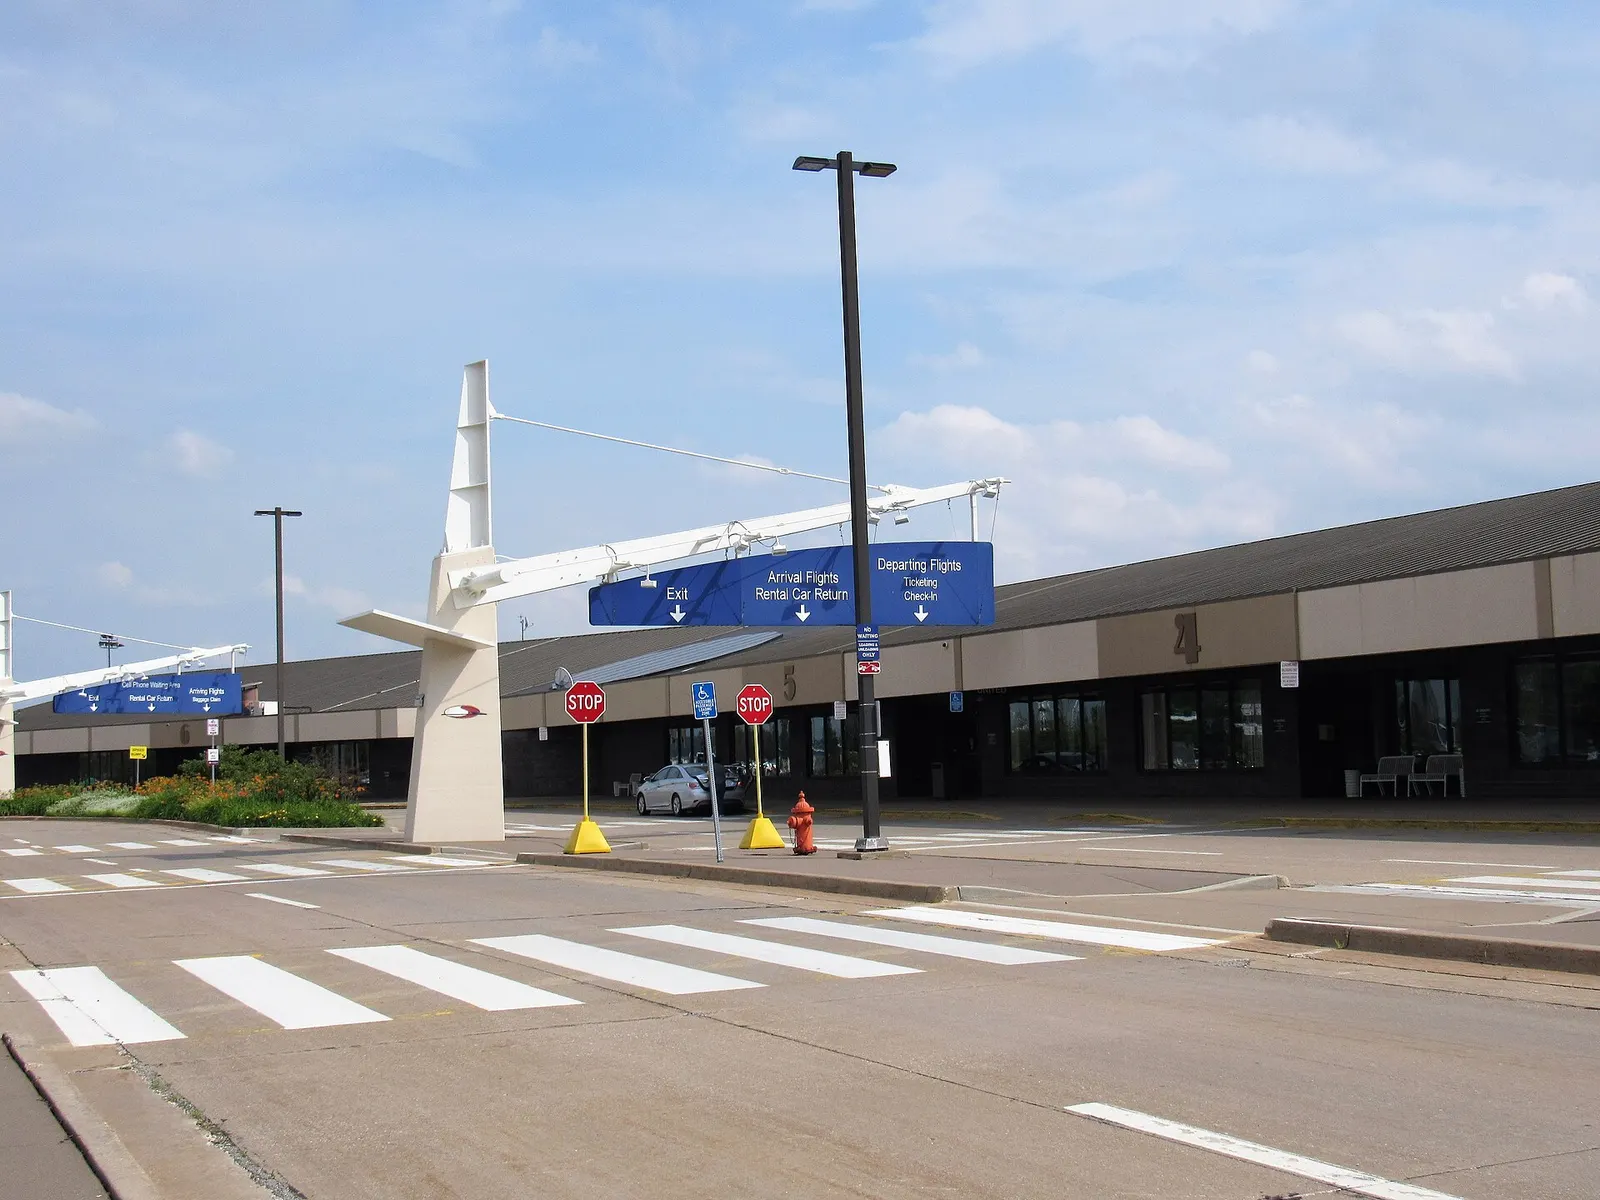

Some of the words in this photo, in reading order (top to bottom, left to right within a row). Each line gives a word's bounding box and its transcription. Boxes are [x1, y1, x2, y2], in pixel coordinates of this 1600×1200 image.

[878, 558, 926, 574] Departing
[930, 558, 962, 574] Flights
[768, 570, 802, 584] Arrival
[806, 570, 839, 586] Flights
[904, 577, 938, 589] Ticketing
[666, 587, 688, 600] Exit
[756, 588, 788, 600] Rental
[792, 588, 812, 600] Car
[815, 588, 848, 600] Return
[904, 590, 938, 601] Check-In
[1174, 612, 1201, 664] 4
[150, 682, 168, 690] Waiting
[784, 665, 796, 701] 5
[568, 694, 602, 709] STOP
[740, 698, 770, 712] STOP
